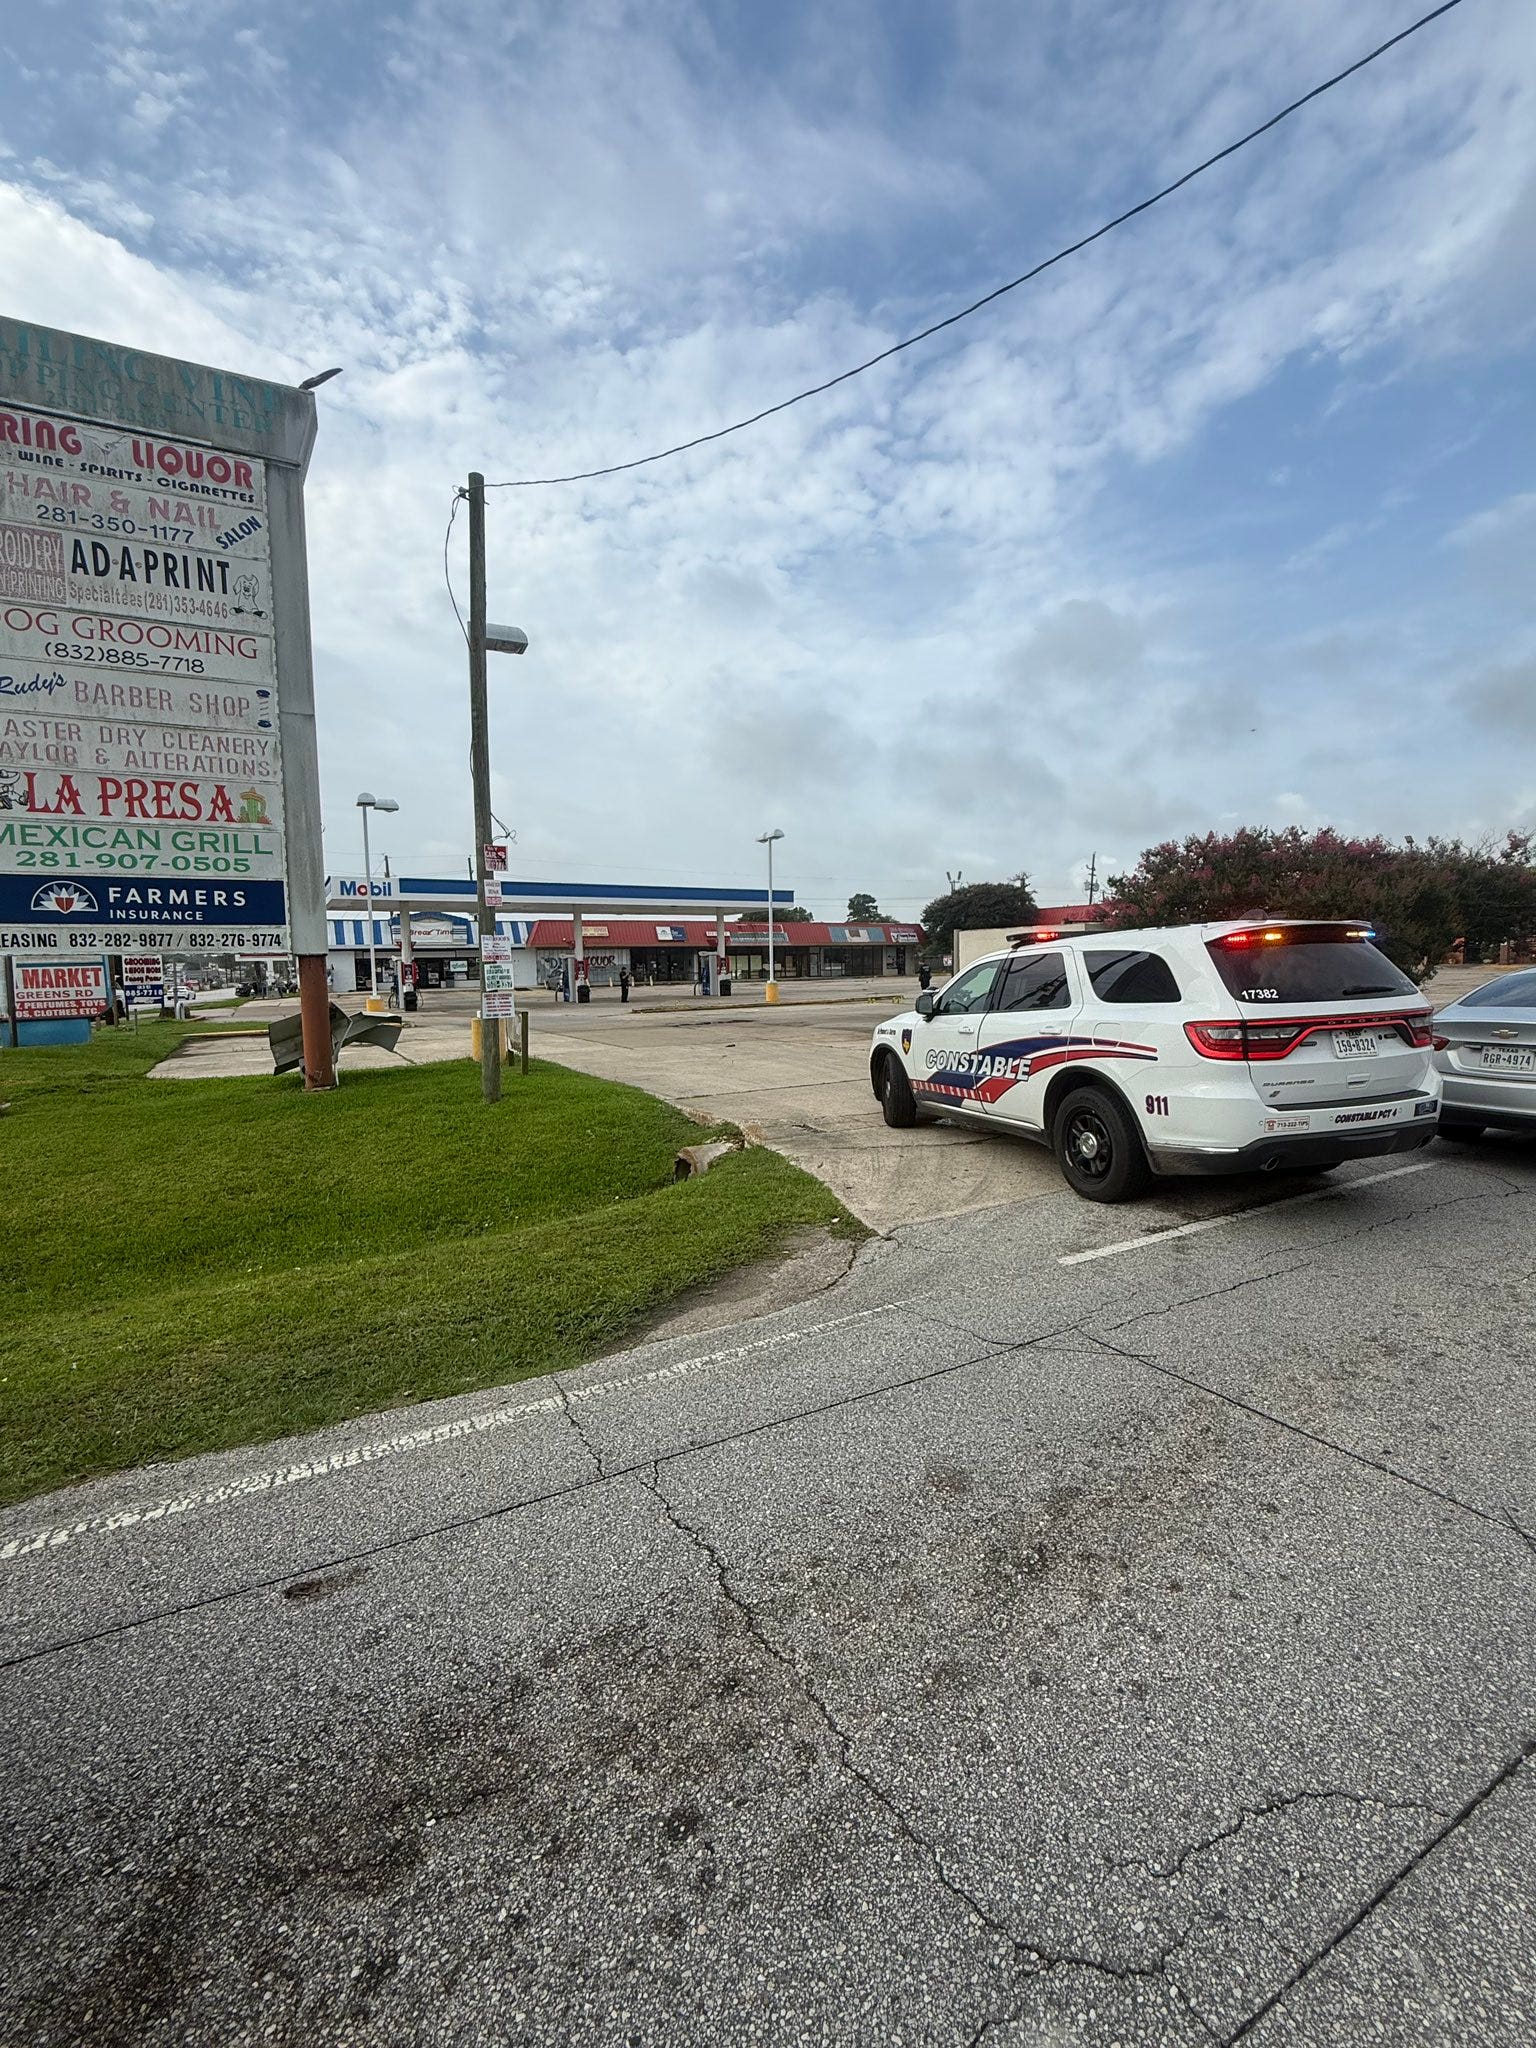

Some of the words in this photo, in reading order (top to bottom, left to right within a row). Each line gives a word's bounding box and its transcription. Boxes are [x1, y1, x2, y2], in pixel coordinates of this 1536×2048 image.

[18, 450, 65, 467] WINE
[80, 462, 142, 483] SPIRITS
[157, 477, 255, 503] CIGARETTES
[131, 440, 253, 490] LIQUOR
[6, 470, 93, 509] HAIR
[110, 490, 130, 516] &
[148, 497, 221, 530] NAIL
[36, 504, 195, 544] 281-350-1177
[215, 515, 263, 550] SALON
[0, 608, 60, 635] OG
[72, 616, 258, 659] GROOMING
[45, 642, 205, 673] (832)885-7718
[0, 671, 67, 697] Rudy's
[74, 680, 173, 712] BARBER
[189, 692, 250, 719] SHOP
[4, 718, 83, 742] ASTER
[99, 725, 147, 748] DRY
[162, 731, 269, 757] CLEANERY
[95, 747, 110, 765] &
[124, 750, 271, 777] ALTERATIONS
[23, 771, 86, 815] LA
[97, 776, 238, 823] PRESA
[171, 830, 274, 855] GRILL
[16, 850, 252, 873] 281-907-0505
[108, 887, 246, 907] FARMERS
[340, 880, 392, 897] Mobil
[110, 909, 204, 921] INSURANCE
[0, 933, 58, 948] EASING
[69, 933, 173, 948] 832-282-9877
[189, 933, 282, 947] 832-276-9774
[21, 967, 102, 989] MARKET
[16, 990, 71, 1000] GREENS
[75, 989, 94, 997] RD
[81, 999, 106, 1007] TOYS
[1241, 988, 1279, 1000] 17382
[34, 1009, 78, 1017] CLOTHES
[925, 1048, 1032, 1082] CONSTABLE
[1145, 1095, 1169, 1116] 911
[1334, 1110, 1378, 1124] CONSTABLE
[1378, 1108, 1392, 1119] PCT
[1392, 1108, 1398, 1117] 4
